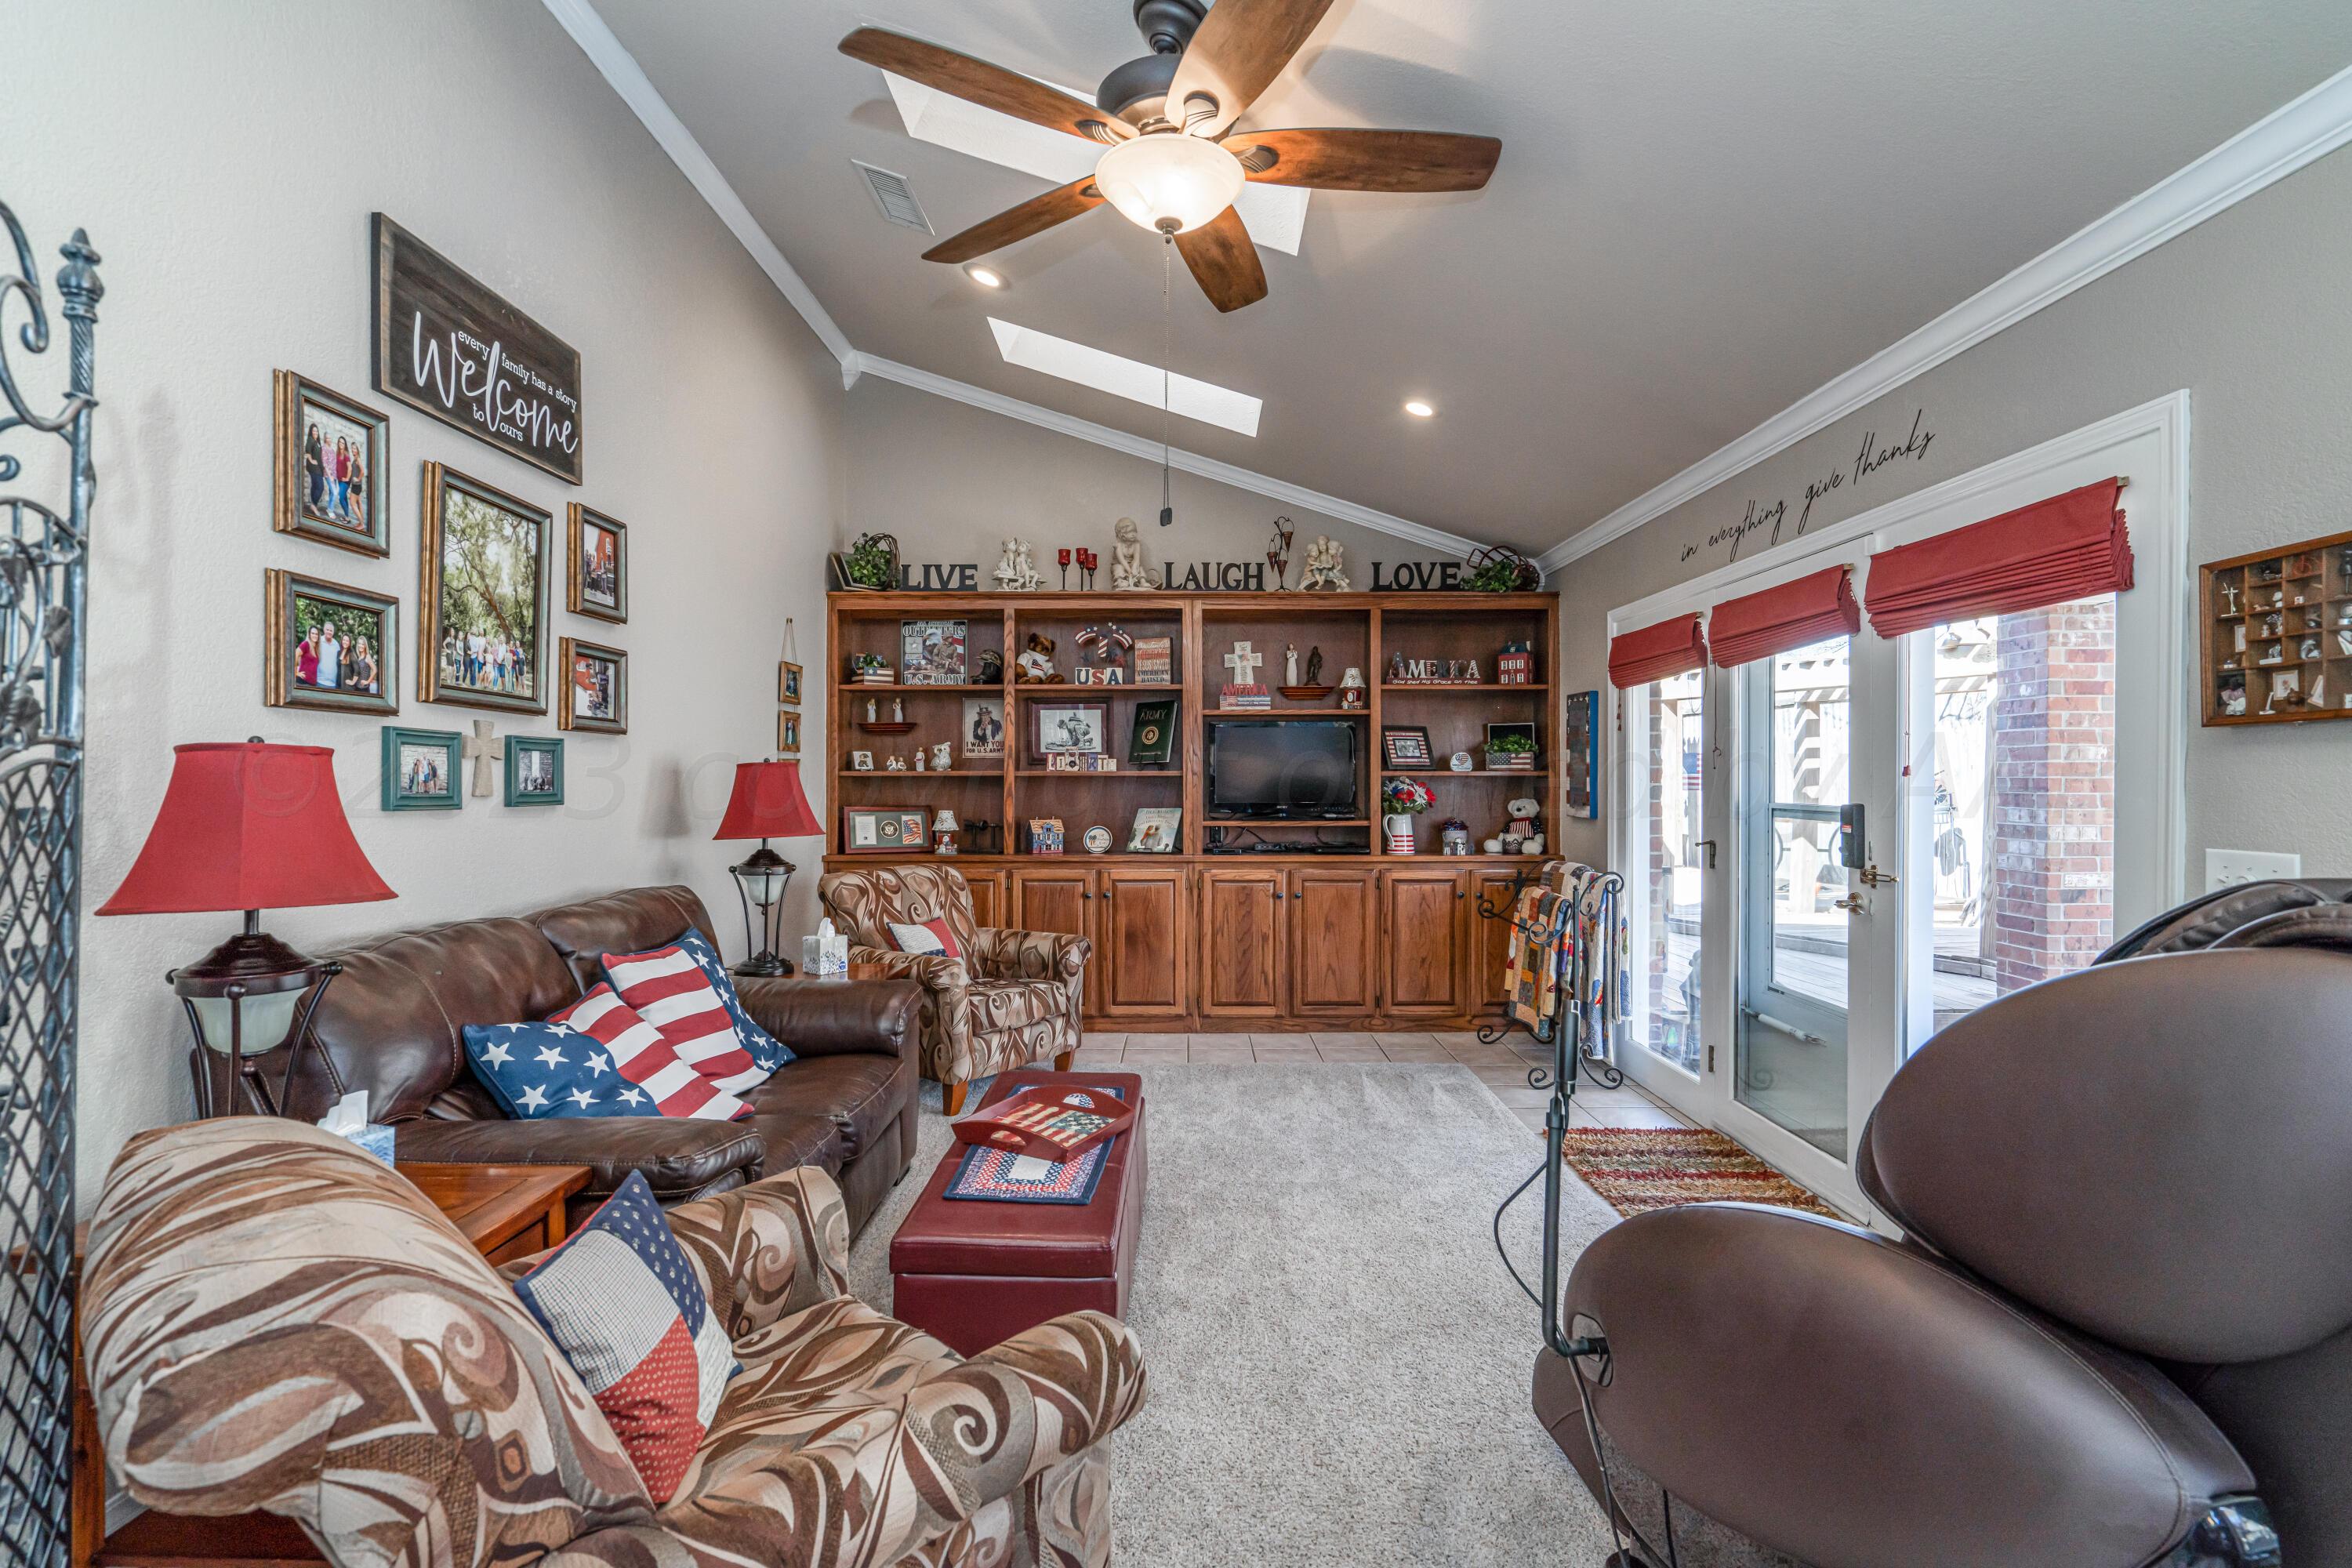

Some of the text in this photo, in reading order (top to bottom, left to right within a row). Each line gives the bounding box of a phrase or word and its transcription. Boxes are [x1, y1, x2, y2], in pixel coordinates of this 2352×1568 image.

[413, 311, 579, 455] Welcome
[458, 330, 577, 413] every family has a story
[473, 403, 524, 442] to ours
[1681, 408, 1937, 563] in everything give thanks
[900, 564, 978, 592] LIVE
[1163, 561, 1265, 592] LAUGH
[1370, 561, 1461, 592] LOVE
[903, 626, 966, 637] OUTFTERS
[904, 674, 966, 684] U.S. ARMY
[1076, 668, 1122, 684] USA
[1388, 652, 1480, 678] AMERICA
[1221, 684, 1268, 695] AMERICA
[1139, 709, 1167, 721] ARMY
